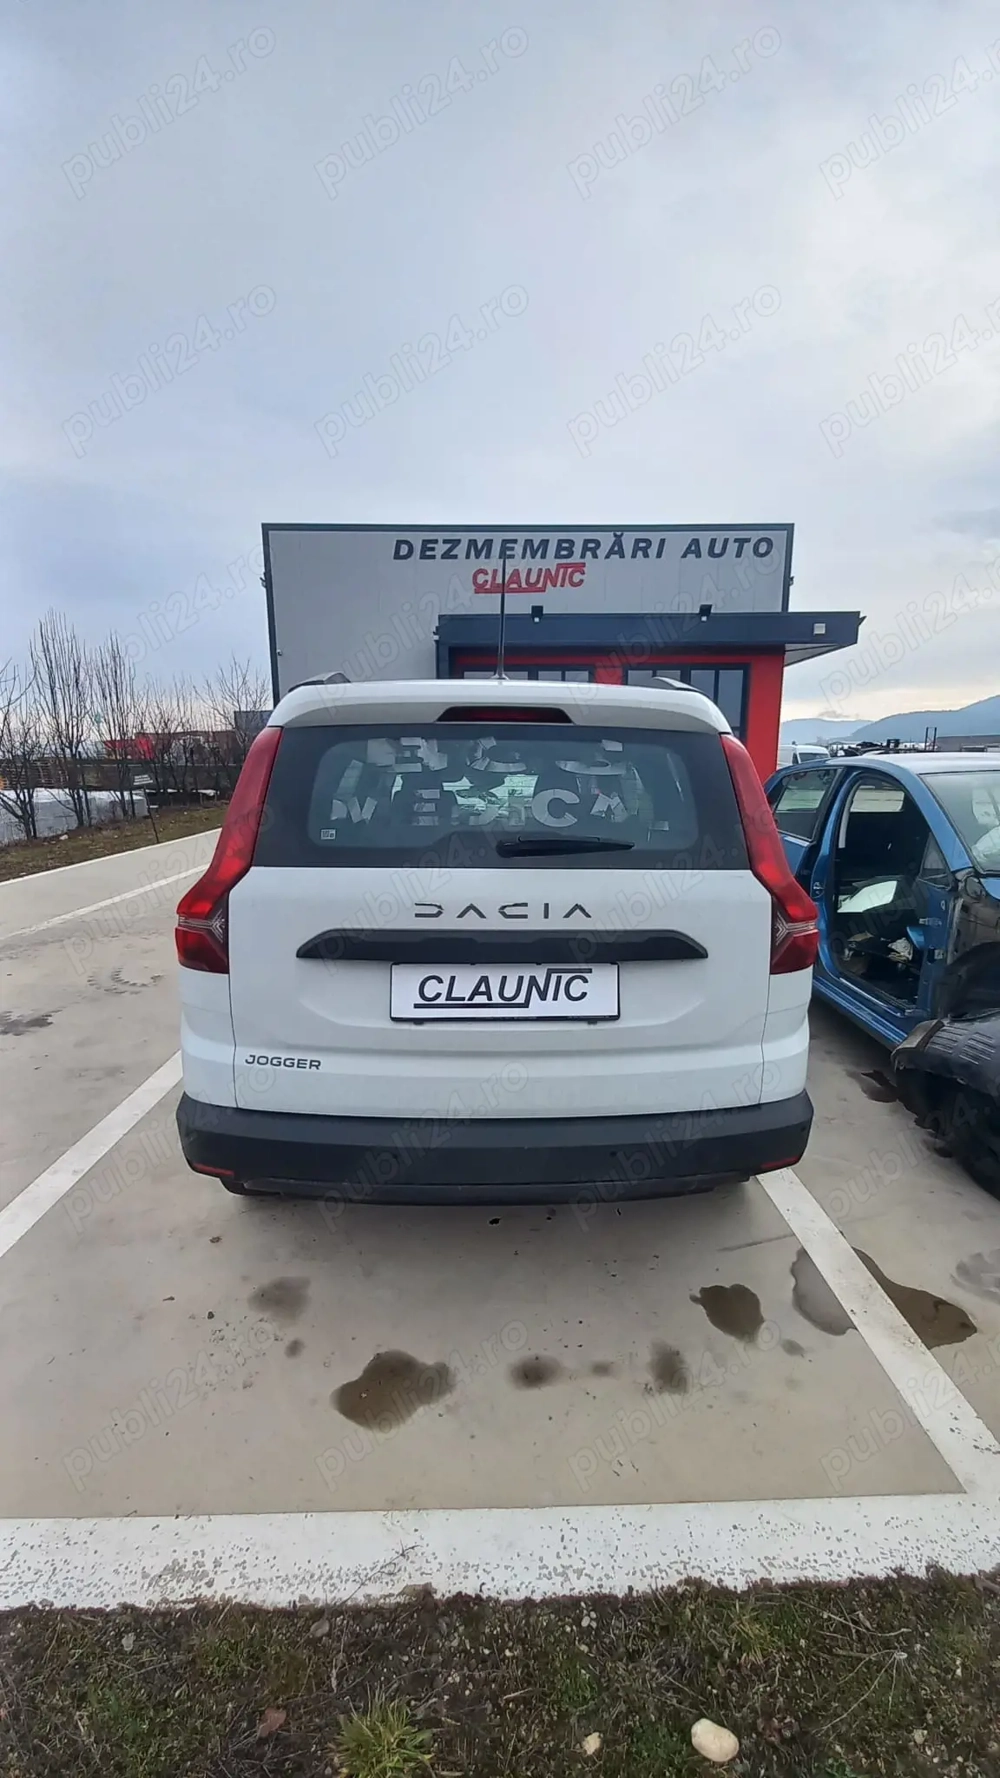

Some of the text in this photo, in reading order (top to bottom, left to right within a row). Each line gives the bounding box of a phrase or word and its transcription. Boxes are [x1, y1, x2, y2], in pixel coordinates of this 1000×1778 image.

[393, 532, 774, 560] DEZMEMBRĂRI AUTO
[472, 562, 586, 594] CLAUNIC
[414, 902, 592, 919] DACIA
[413, 968, 592, 1009] CLAUNIC
[245, 1054, 322, 1070] JOGGER
